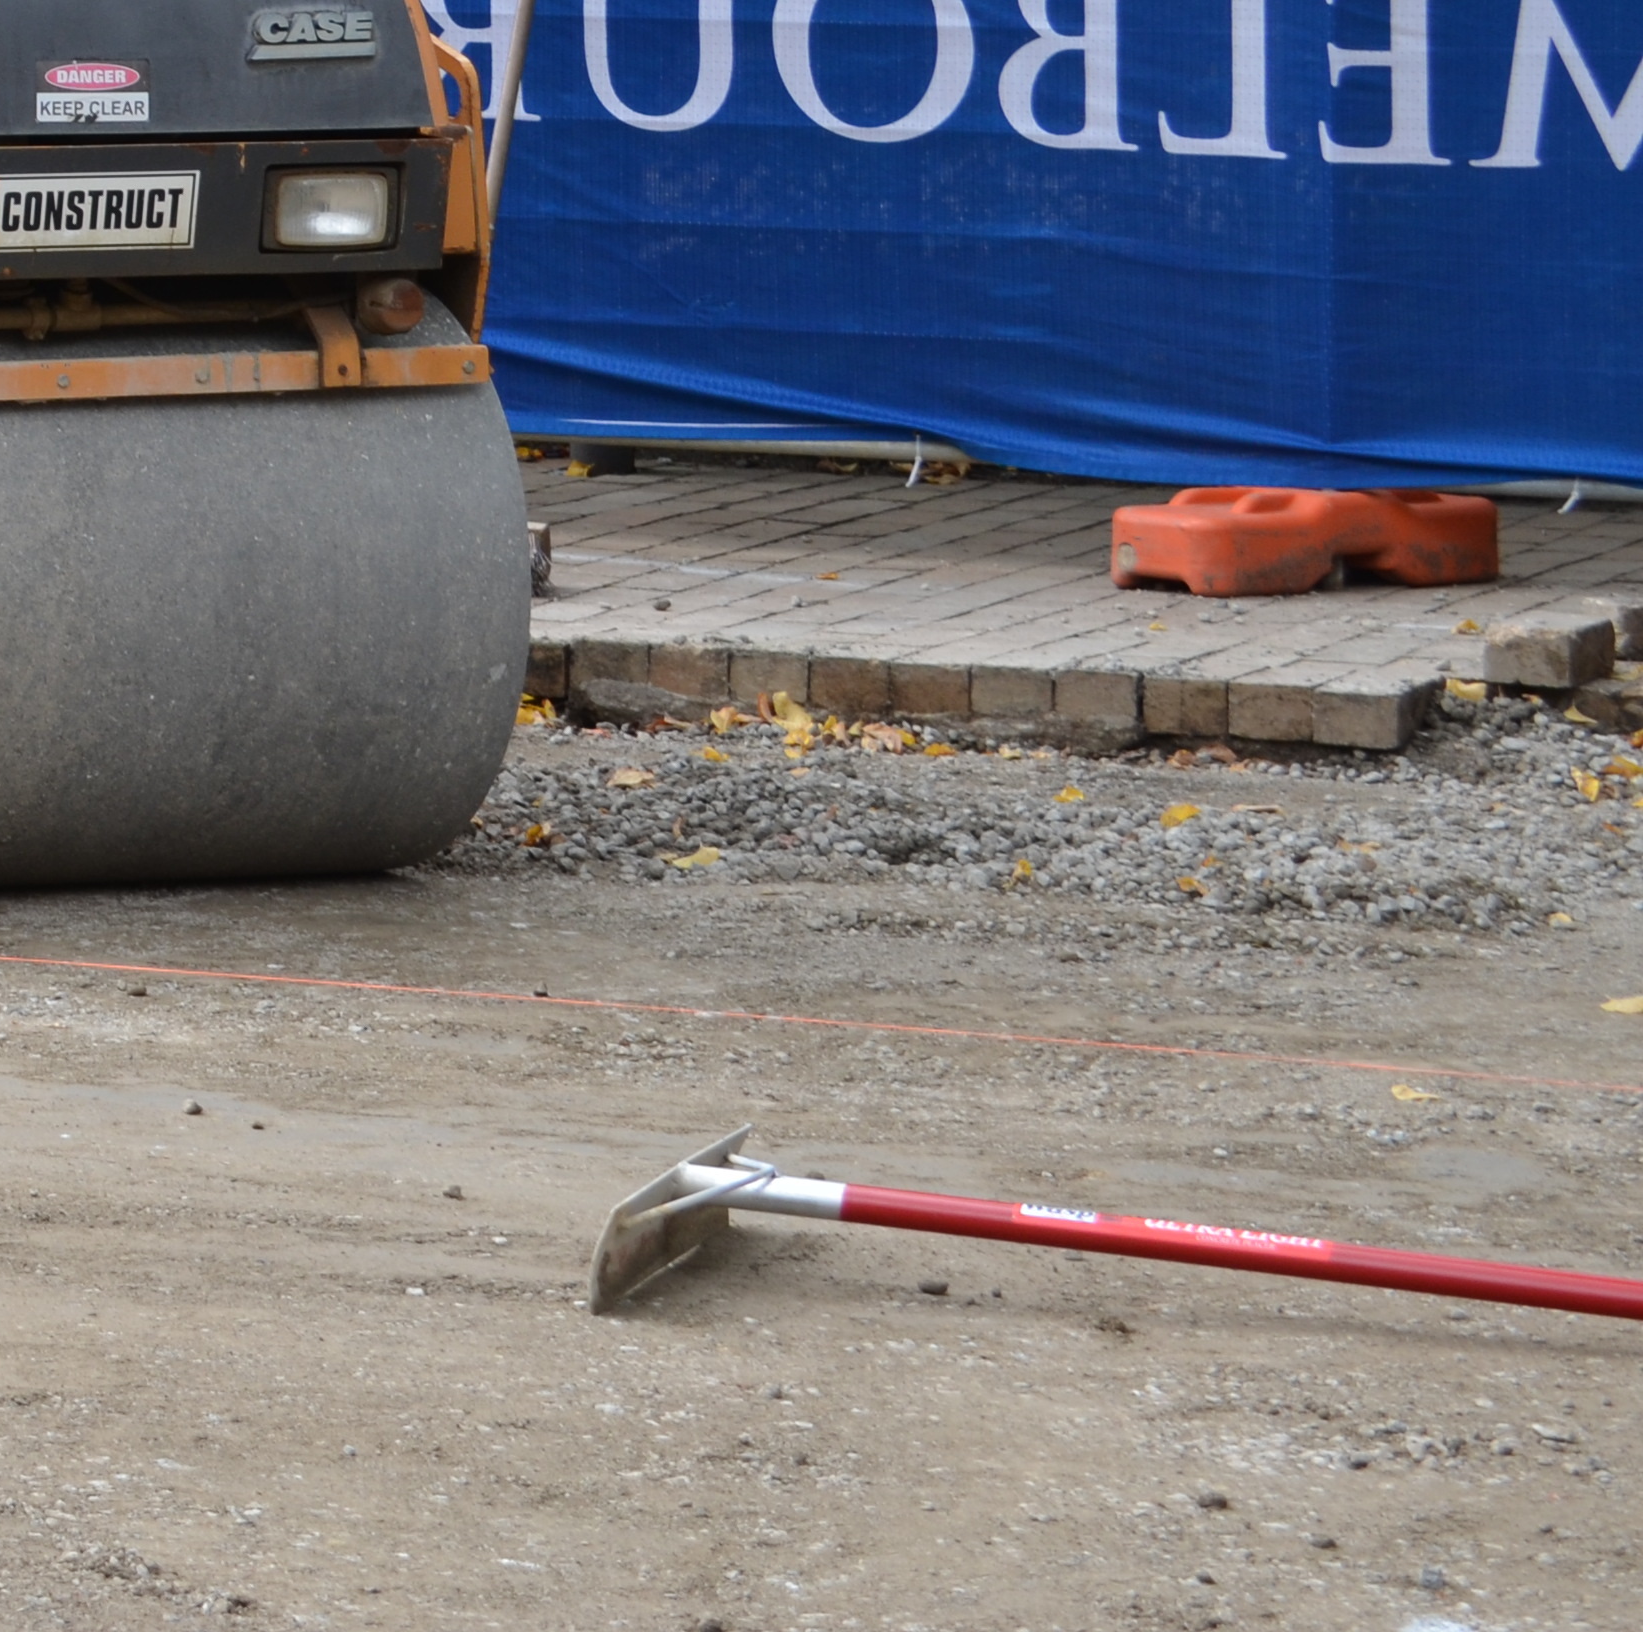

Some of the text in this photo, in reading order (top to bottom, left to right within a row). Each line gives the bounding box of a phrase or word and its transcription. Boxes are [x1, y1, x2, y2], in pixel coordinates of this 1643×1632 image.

[256, 11, 374, 44] CASE
[56, 69, 127, 85] DANGER
[39, 100, 146, 117] KEEP CLEAR
[1, 187, 184, 232] CONSTRUCT
